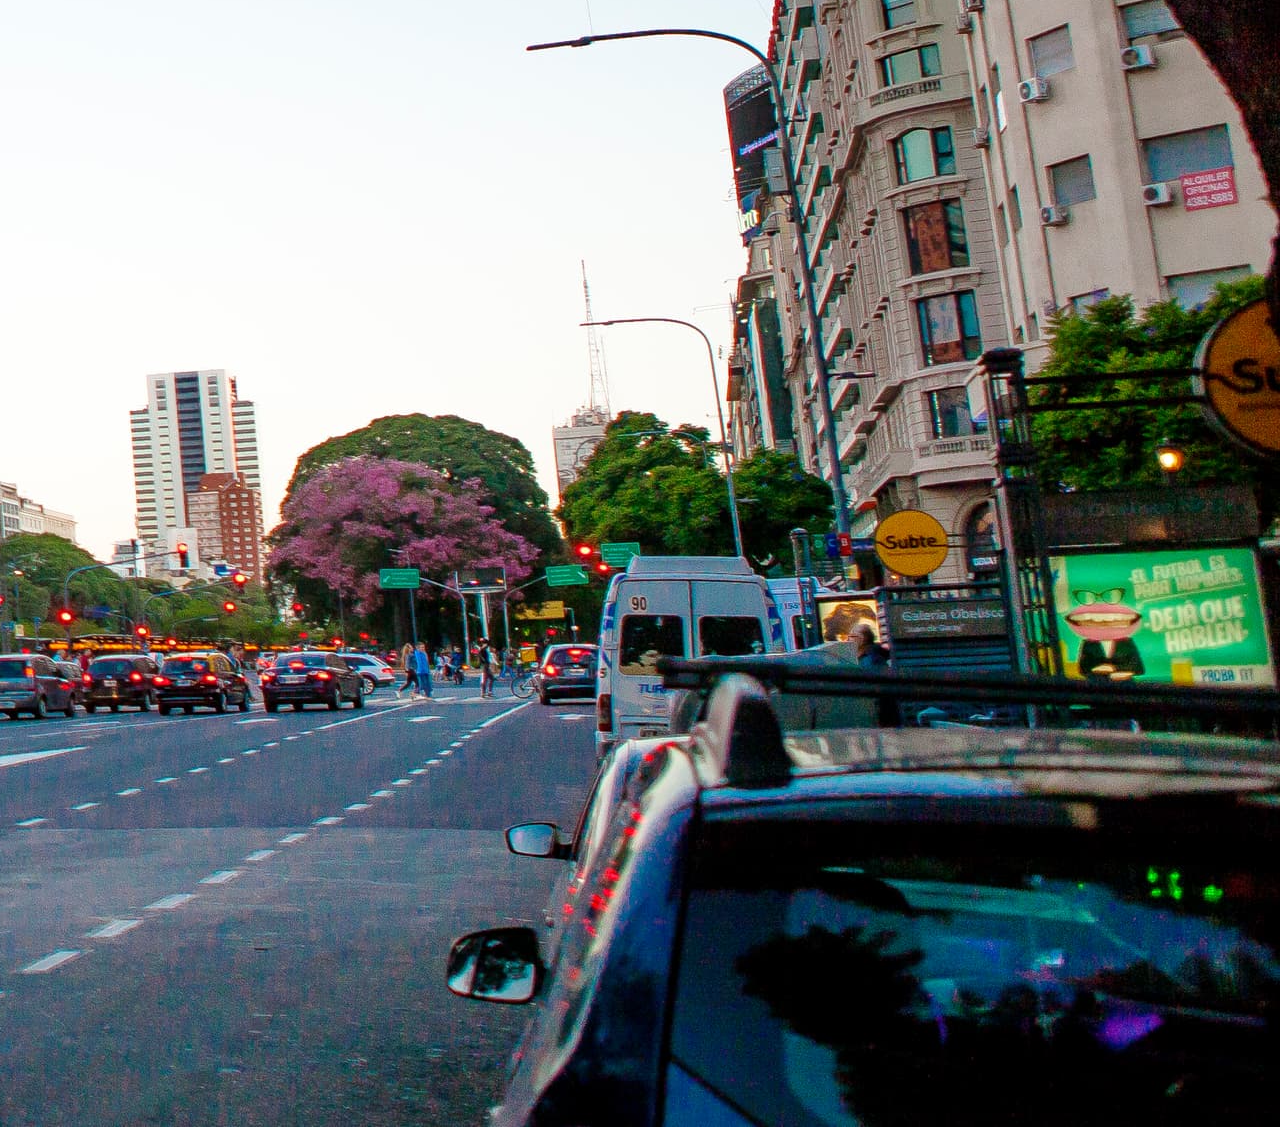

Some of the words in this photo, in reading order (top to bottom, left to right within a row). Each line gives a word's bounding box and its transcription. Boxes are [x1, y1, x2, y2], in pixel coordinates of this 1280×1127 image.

[884, 534, 938, 550] Subte
[631, 596, 647, 611] 90
[1200, 596, 1245, 623] QUE
